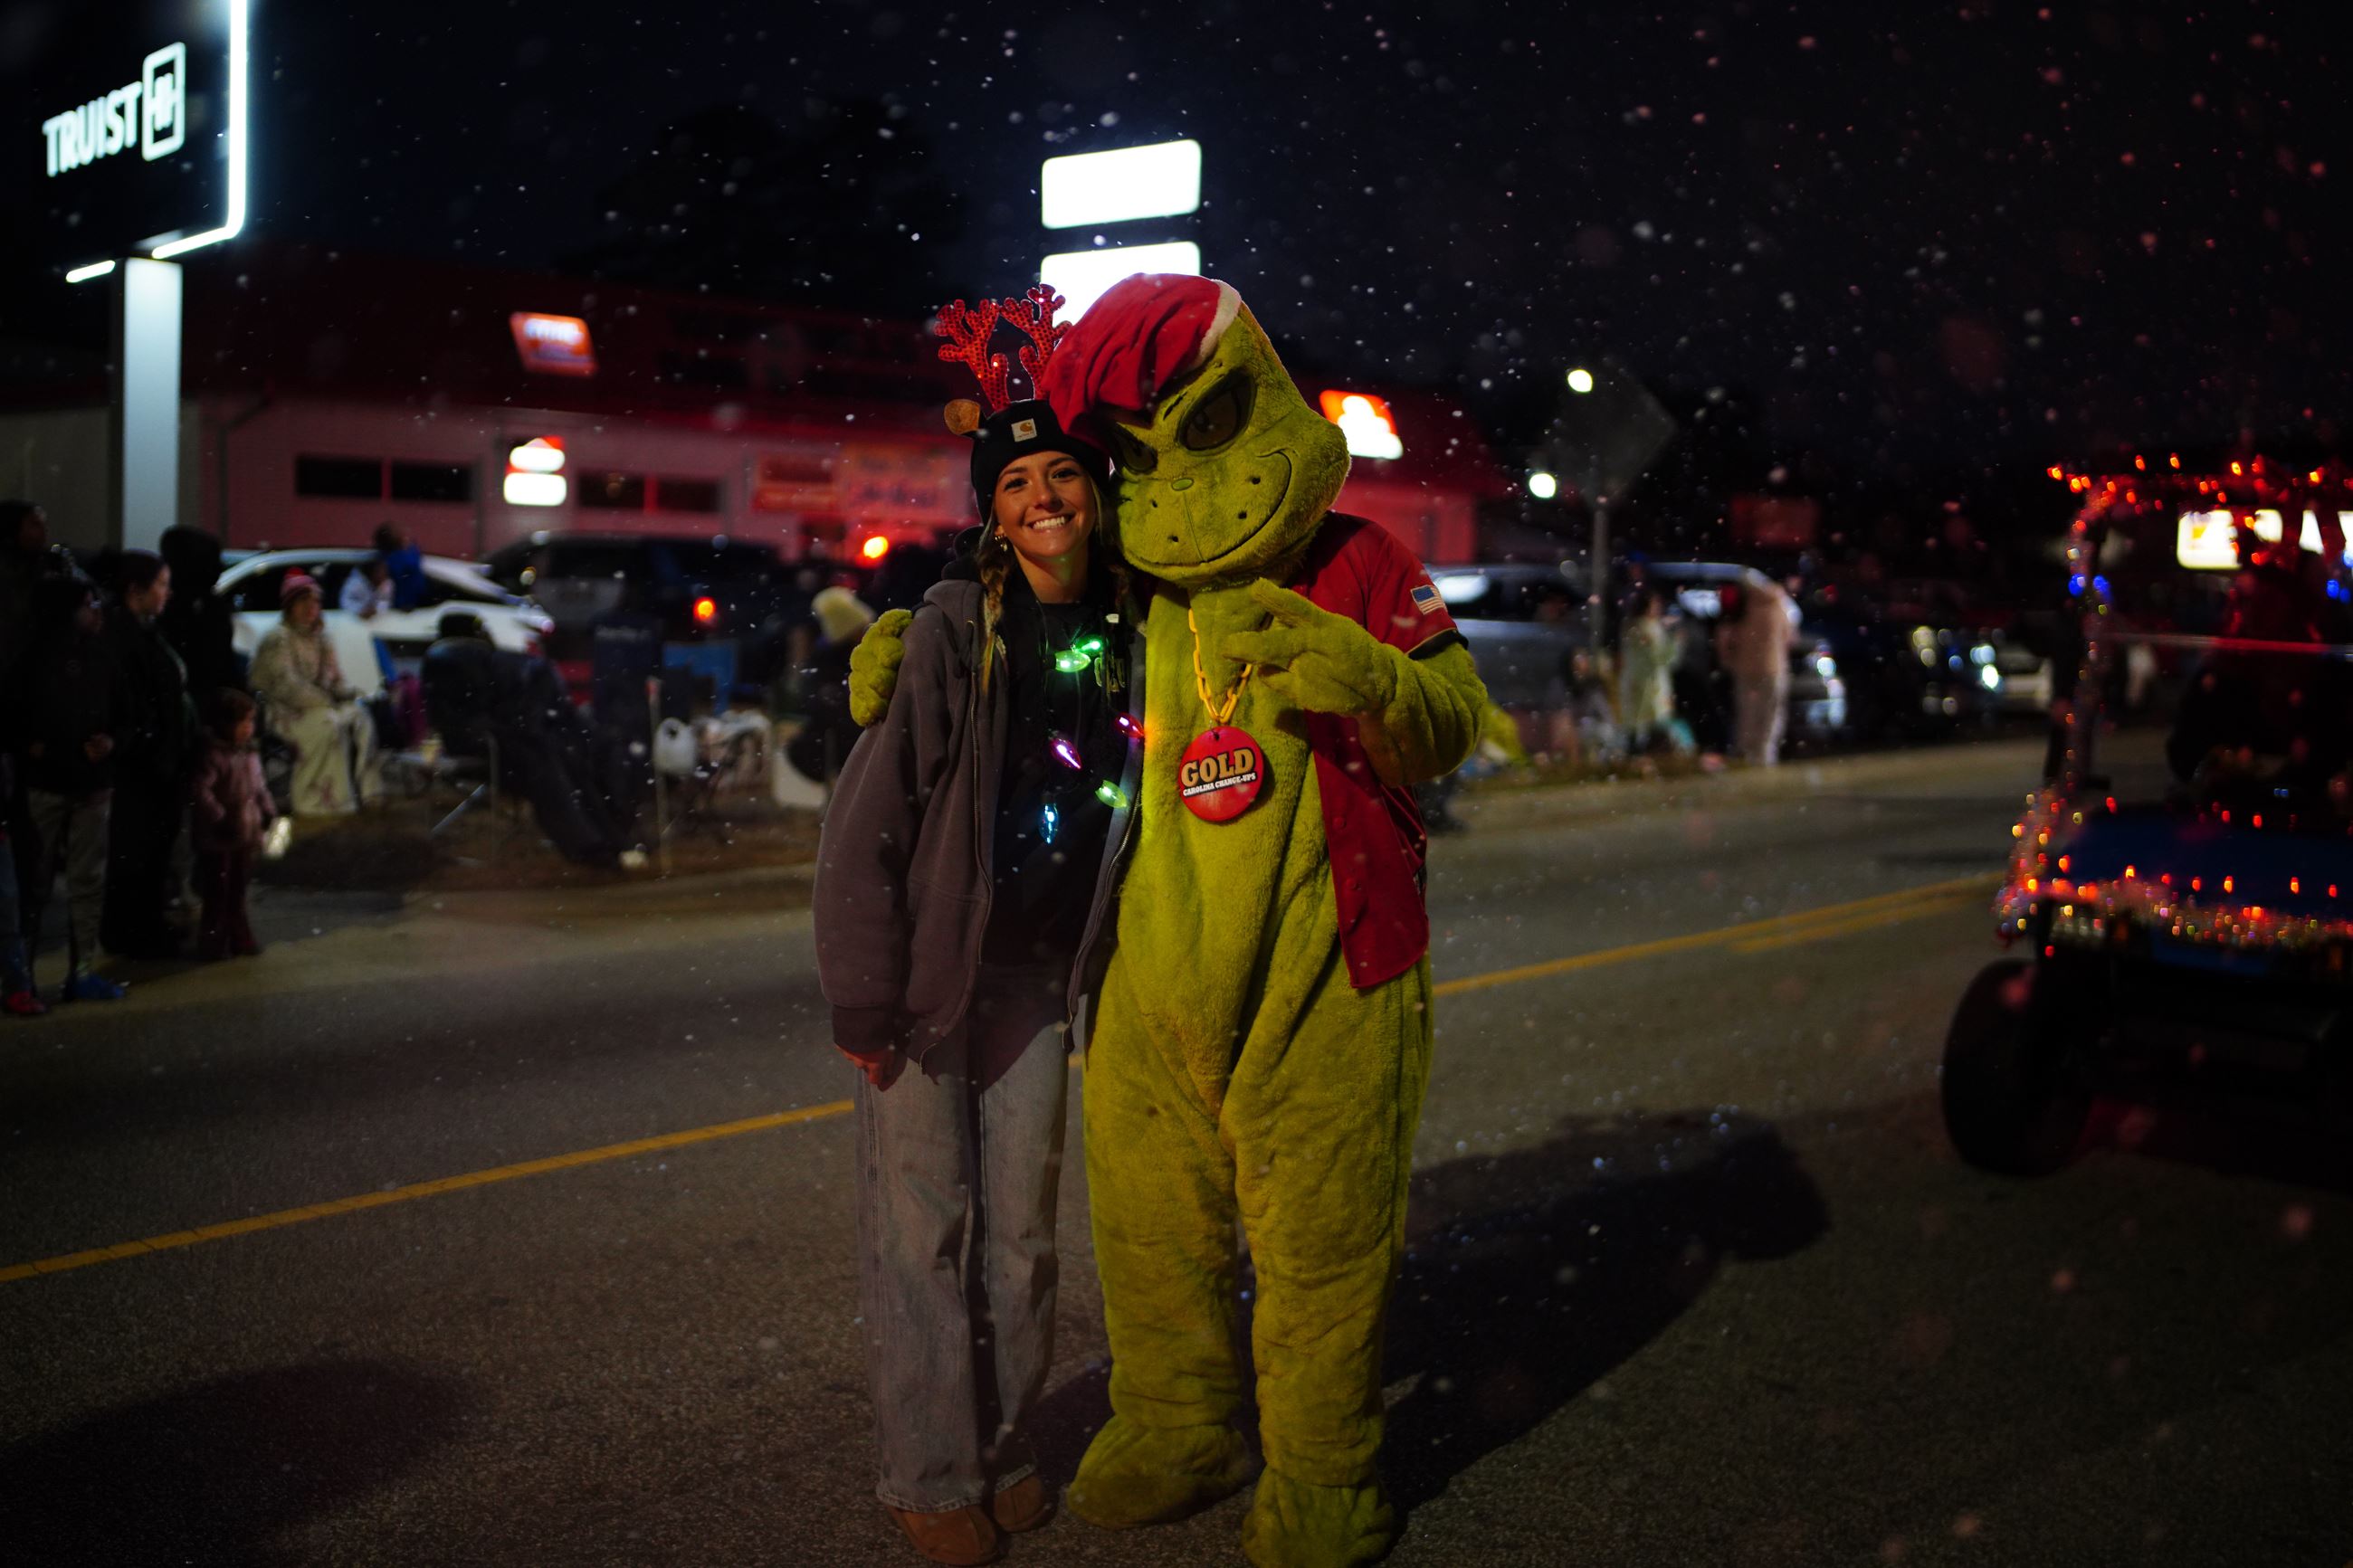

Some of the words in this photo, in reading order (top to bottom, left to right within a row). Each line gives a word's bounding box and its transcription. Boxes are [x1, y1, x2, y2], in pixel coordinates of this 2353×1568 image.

[43, 81, 143, 176] TRUIST
[1181, 748, 1254, 787] GOLD
[1183, 783, 1215, 796] CAROLINA
